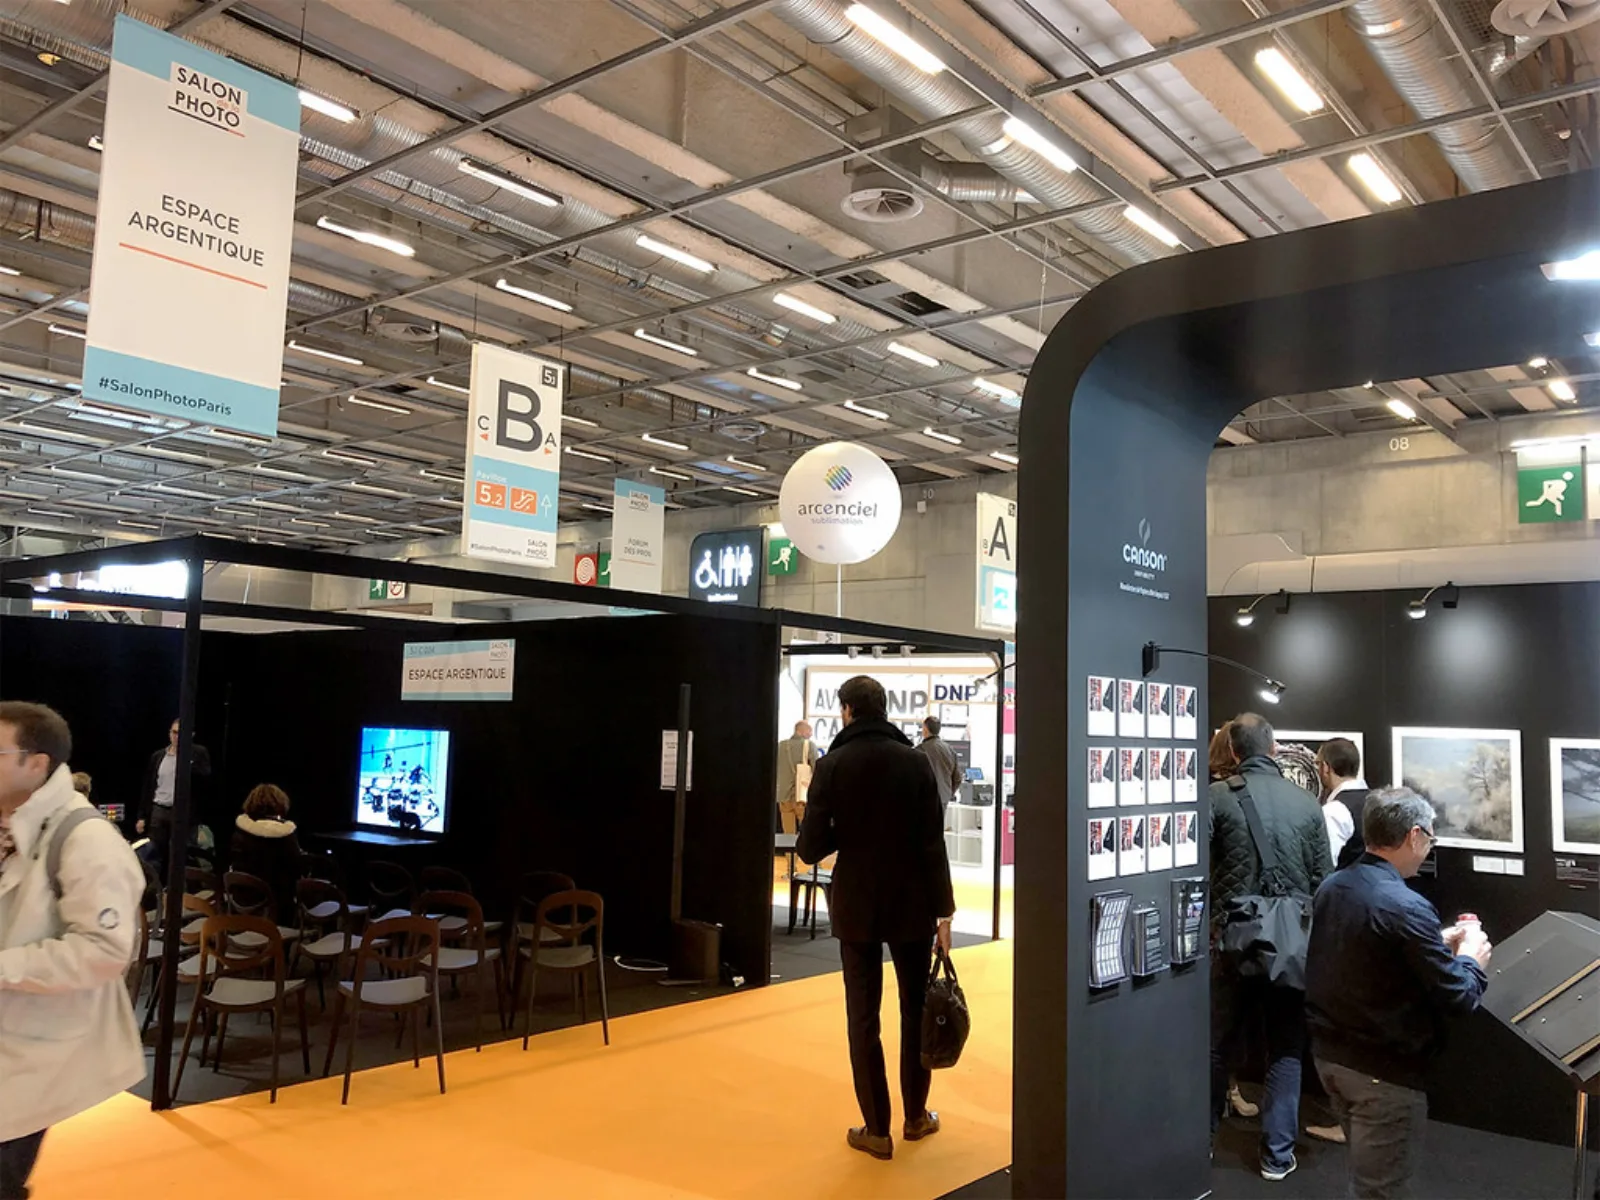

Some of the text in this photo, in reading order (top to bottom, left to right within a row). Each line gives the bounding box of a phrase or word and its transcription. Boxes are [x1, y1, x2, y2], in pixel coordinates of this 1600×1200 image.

[177, 67, 241, 105] SALON
[175, 90, 240, 127] PHOTO
[161, 194, 240, 234] ESPACE
[128, 211, 264, 267] ARGENTIQUE
[99, 377, 232, 416] #SalonPhotoParis
[477, 378, 557, 452] C B A
[1389, 437, 1409, 450] 08
[480, 484, 503, 506] 5.2
[798, 501, 878, 517] arcenciel
[988, 516, 1011, 561] A
[409, 668, 506, 680] ESPACE ARGENTIQUE
[934, 684, 978, 701] DNP
